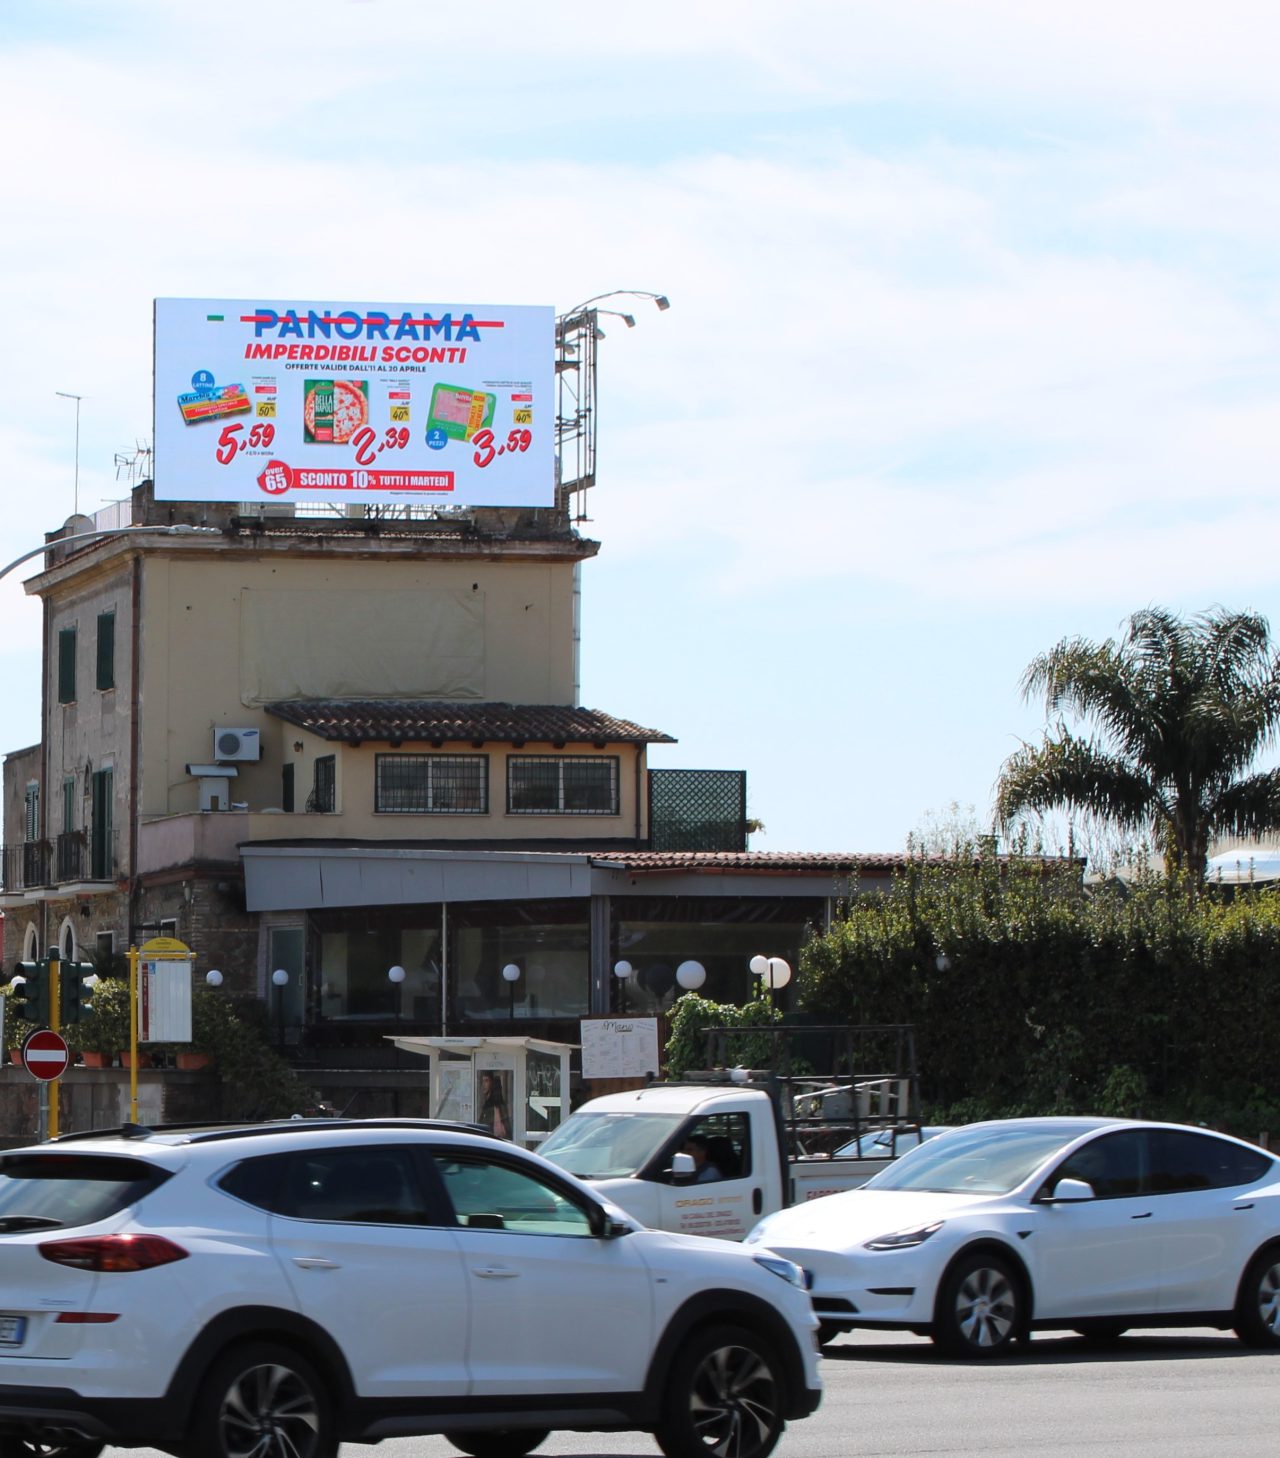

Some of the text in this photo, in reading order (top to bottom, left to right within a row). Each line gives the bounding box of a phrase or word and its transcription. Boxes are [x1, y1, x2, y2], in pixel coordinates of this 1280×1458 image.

[254, 309, 481, 342] PANORAMA
[244, 343, 467, 363] IMPERDIBILI SCONTI
[285, 363, 319, 371] OFFERTE
[320, 363, 347, 371] VALIDE
[349, 364, 376, 372] DALL'11
[399, 365, 426, 373] APRILE
[199, 373, 206, 382] 8
[315, 395, 332, 404] BELLA
[258, 405, 275, 416] 50%
[392, 410, 409, 421] 40%
[515, 414, 531, 423] 40%
[433, 431, 440, 439] 2
[216, 422, 275, 465] 5,59
[352, 426, 410, 466] 2,39
[472, 428, 532, 469] 3,59
[265, 466, 284, 475] over
[265, 474, 287, 491] 65
[300, 472, 347, 487] SCONTO
[350, 470, 376, 488] 10%
[379, 475, 405, 486] TUTTI
[410, 474, 448, 487] MARTEDÌ
